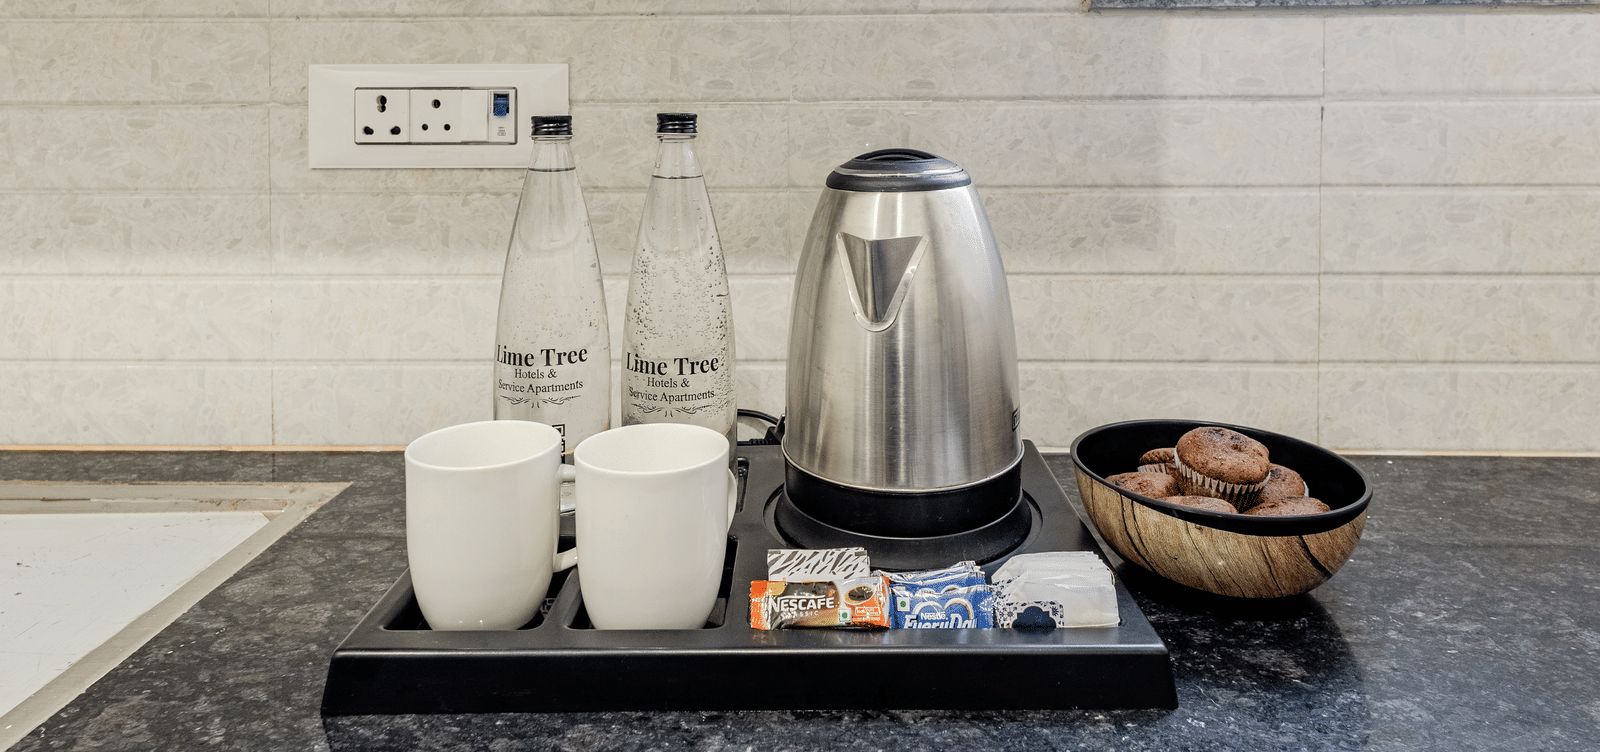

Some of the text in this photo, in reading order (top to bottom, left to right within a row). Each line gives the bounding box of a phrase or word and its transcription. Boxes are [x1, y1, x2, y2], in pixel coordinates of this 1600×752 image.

[497, 344, 588, 367] Lime Tree
[626, 352, 719, 376] Lime Tree
[514, 368, 558, 379] Hotels &
[647, 377, 690, 388] Hotels &
[498, 379, 584, 396] Service Apartments
[628, 386, 715, 405] Service Apartments
